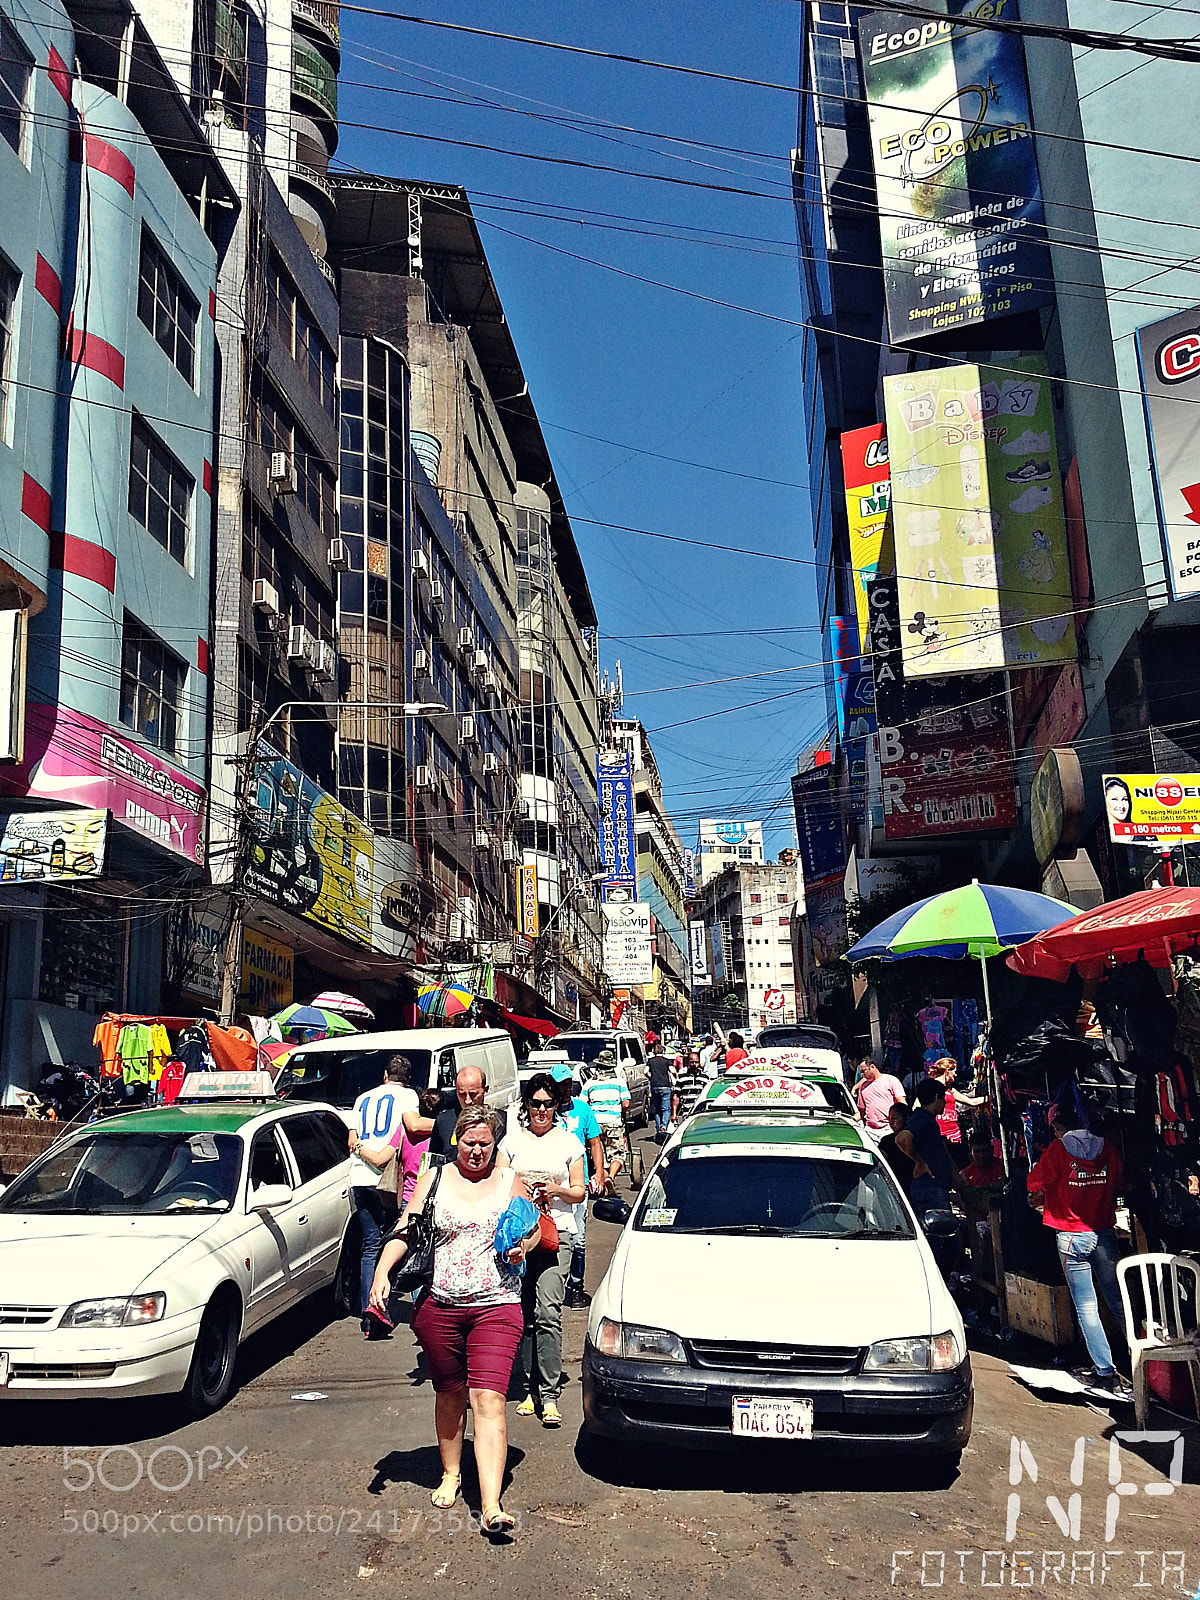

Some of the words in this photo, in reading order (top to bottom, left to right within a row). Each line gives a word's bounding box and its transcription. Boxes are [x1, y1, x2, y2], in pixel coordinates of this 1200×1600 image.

[870, 1, 1004, 57] Ecopower
[880, 121, 951, 159] ECO
[935, 122, 1029, 163] POWER
[1006, 196, 1025, 210] de
[899, 235, 952, 260] sonidos
[955, 216, 1028, 245] accesorios
[913, 261, 932, 276] de
[920, 284, 931, 299] y
[933, 262, 1016, 294] Electrónicos
[908, 300, 957, 321] Shopping
[959, 293, 984, 308] HWU
[1010, 281, 1033, 293] Piso
[933, 311, 964, 329] Lojas:
[967, 300, 1011, 319] 102/103
[909, 388, 1033, 422] Baby
[871, 588, 895, 682] CASA
[616, 782, 627, 792] &
[125, 798, 172, 843] PUMA
[602, 782, 617, 875] RESTAURANTE
[616, 794, 631, 874] CAFETERIA
[716, 822, 747, 836] CELL
[1133, 825, 1149, 834] 180
[1151, 825, 1182, 834] metros
[525, 869, 535, 933] FARMACIA
[1073, 898, 1198, 932] Coca-Cola
[244, 941, 292, 982] FARMÁCIA
[230, 1073, 261, 1085] TAXI
[735, 1057, 767, 1070] RADIO
[770, 1059, 793, 1072] TAXI
[725, 1078, 774, 1099] RADIO
[779, 1080, 813, 1100] TAXI
[359, 1094, 395, 1140] 10
[754, 1402, 790, 1411] PARAGUAY
[776, 1413, 805, 1435] 054
